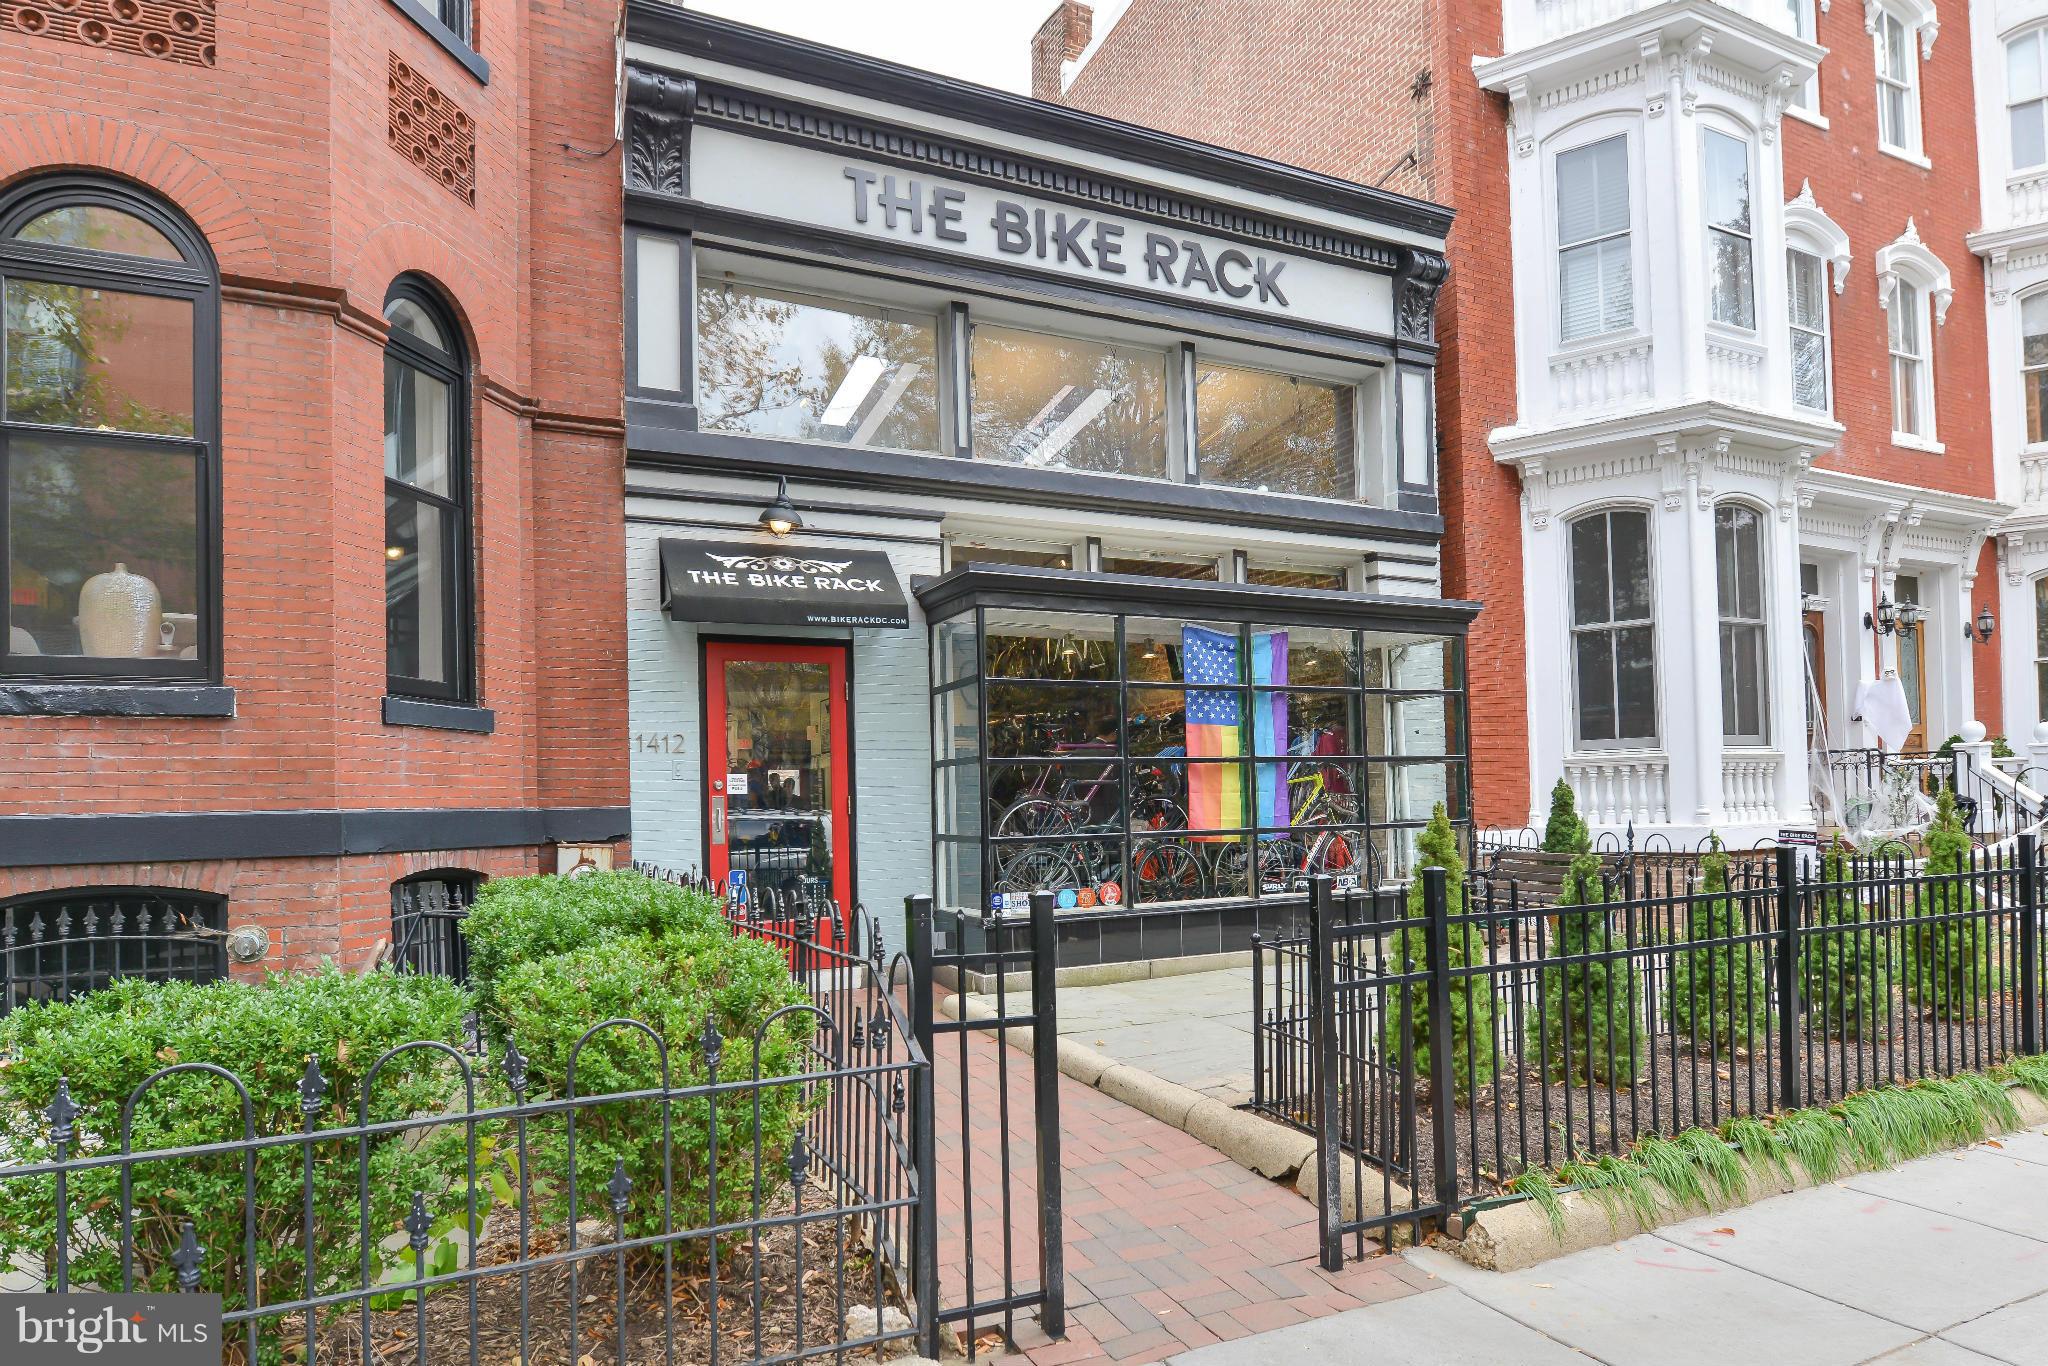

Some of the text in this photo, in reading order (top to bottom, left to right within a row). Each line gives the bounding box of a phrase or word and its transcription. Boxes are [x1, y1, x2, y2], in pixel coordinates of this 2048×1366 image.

[844, 167, 1289, 306] THE BIKE RACK
[687, 570, 885, 592] THE BIKE RACK
[807, 615, 907, 625] WWW.BIKERACKDC.COM
[635, 733, 685, 753] 1412
[1262, 882, 1287, 890] SURLY
